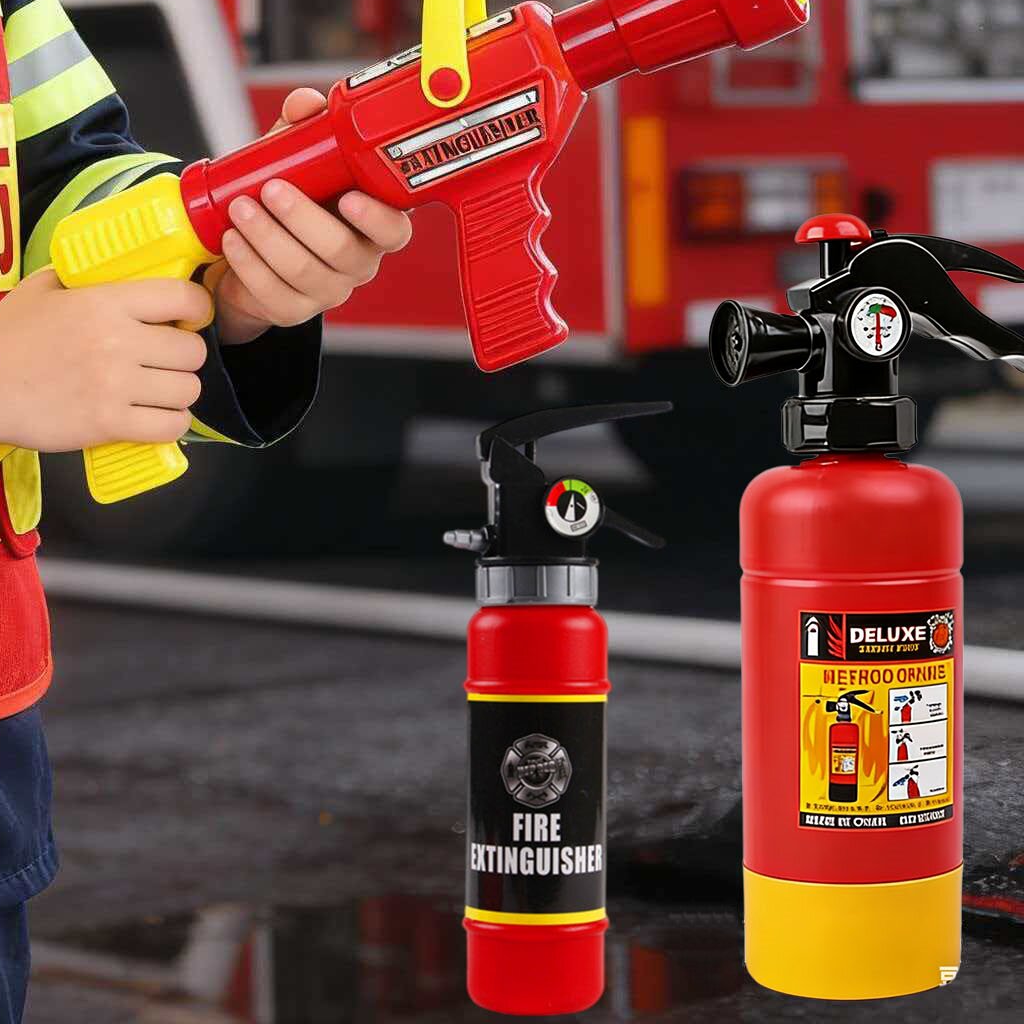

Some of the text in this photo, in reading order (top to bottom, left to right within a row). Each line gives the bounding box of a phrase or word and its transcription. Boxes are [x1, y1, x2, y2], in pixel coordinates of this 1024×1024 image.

[850, 625, 926, 644] DELUXE
[512, 812, 562, 842] FIRE
[470, 842, 603, 876] EXTINGUISHER
